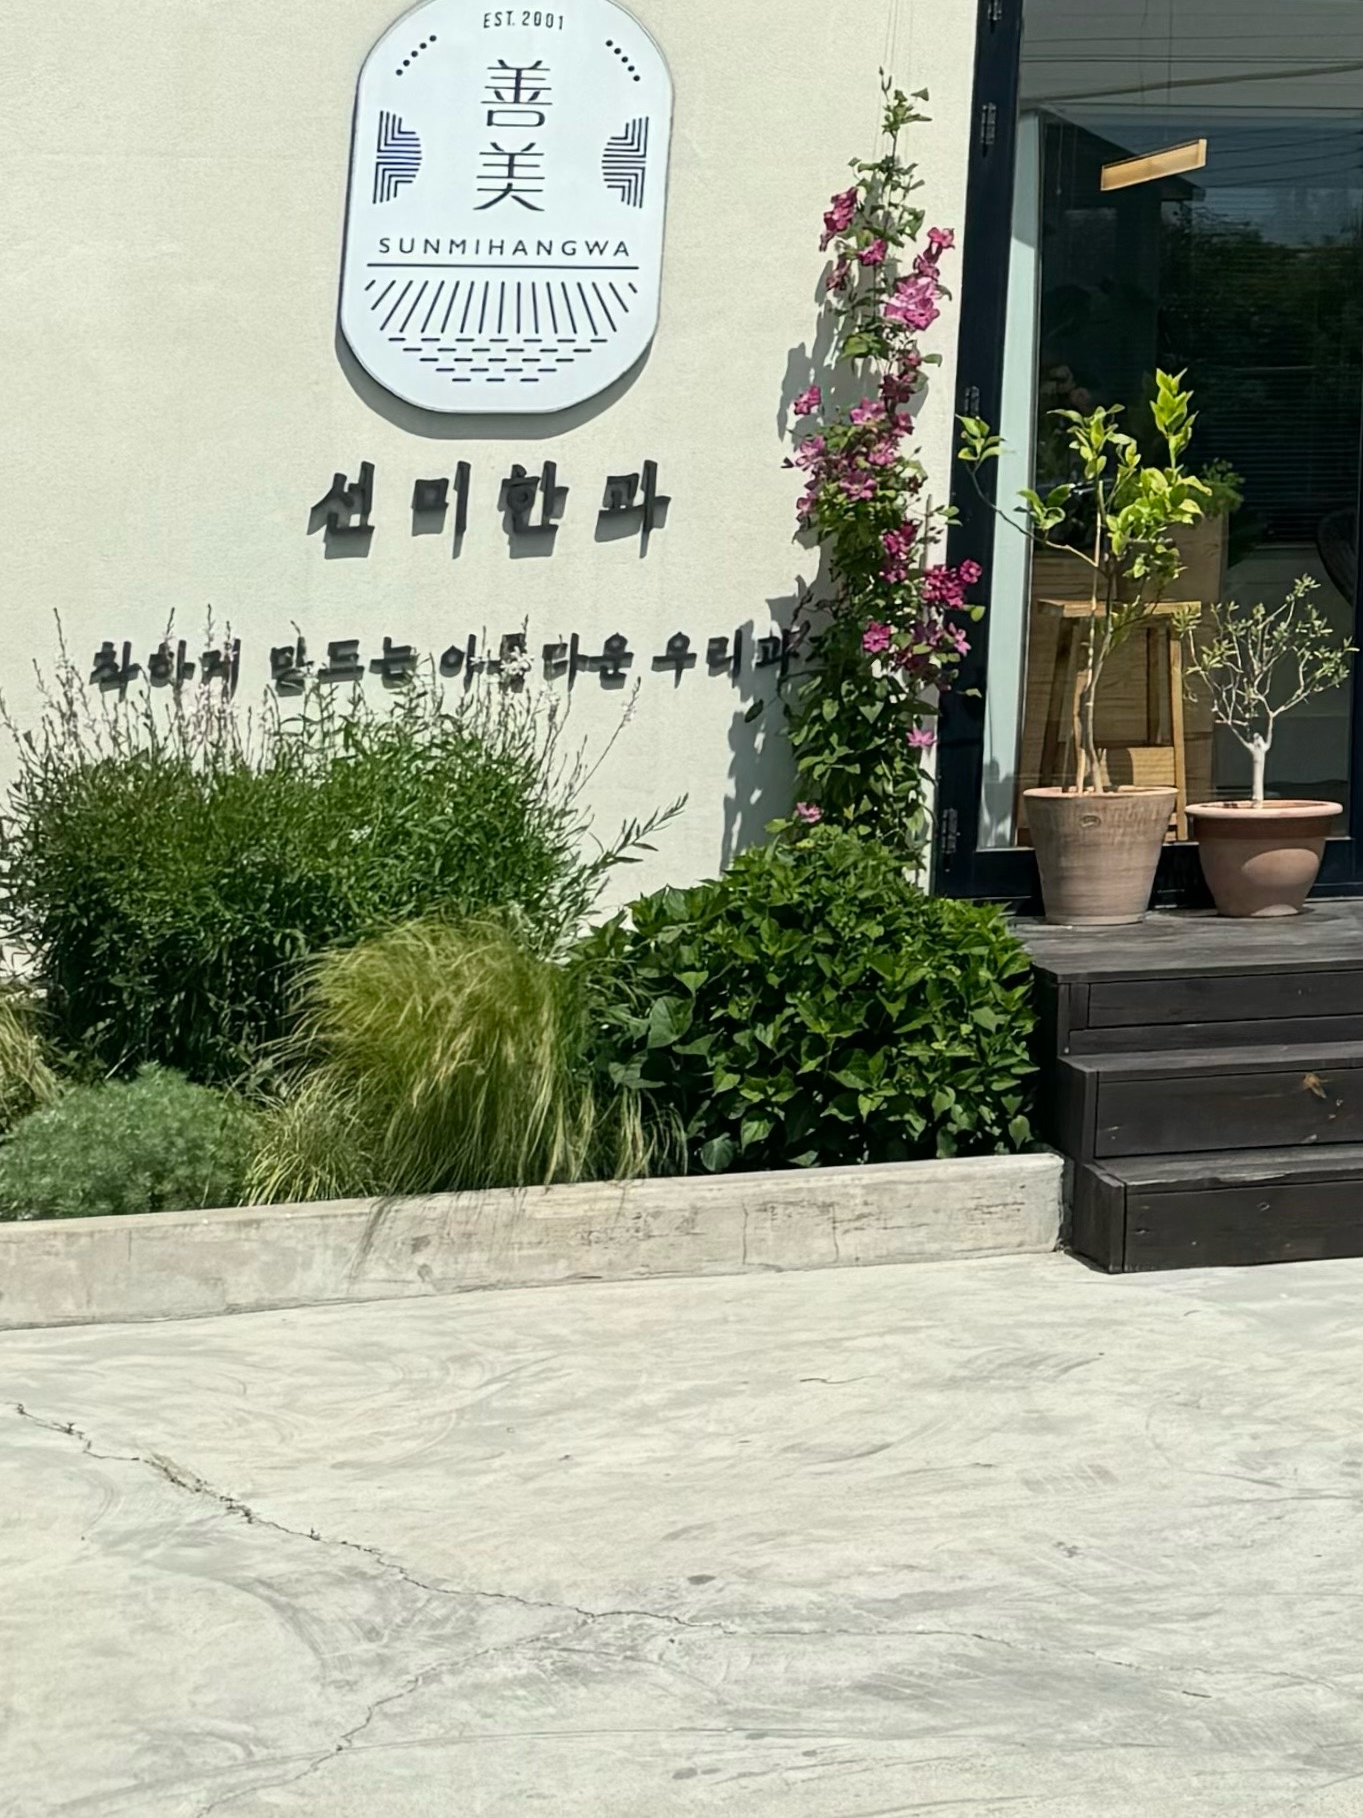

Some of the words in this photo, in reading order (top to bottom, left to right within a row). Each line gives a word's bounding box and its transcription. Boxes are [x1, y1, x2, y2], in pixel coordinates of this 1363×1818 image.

[521, 10, 564, 30] 2001
[472, 58, 553, 212] 善美
[378, 237, 631, 257] SUNMIHANGWA
[308, 460, 671, 537] 선미한과
[270, 635, 413, 692] 만드는
